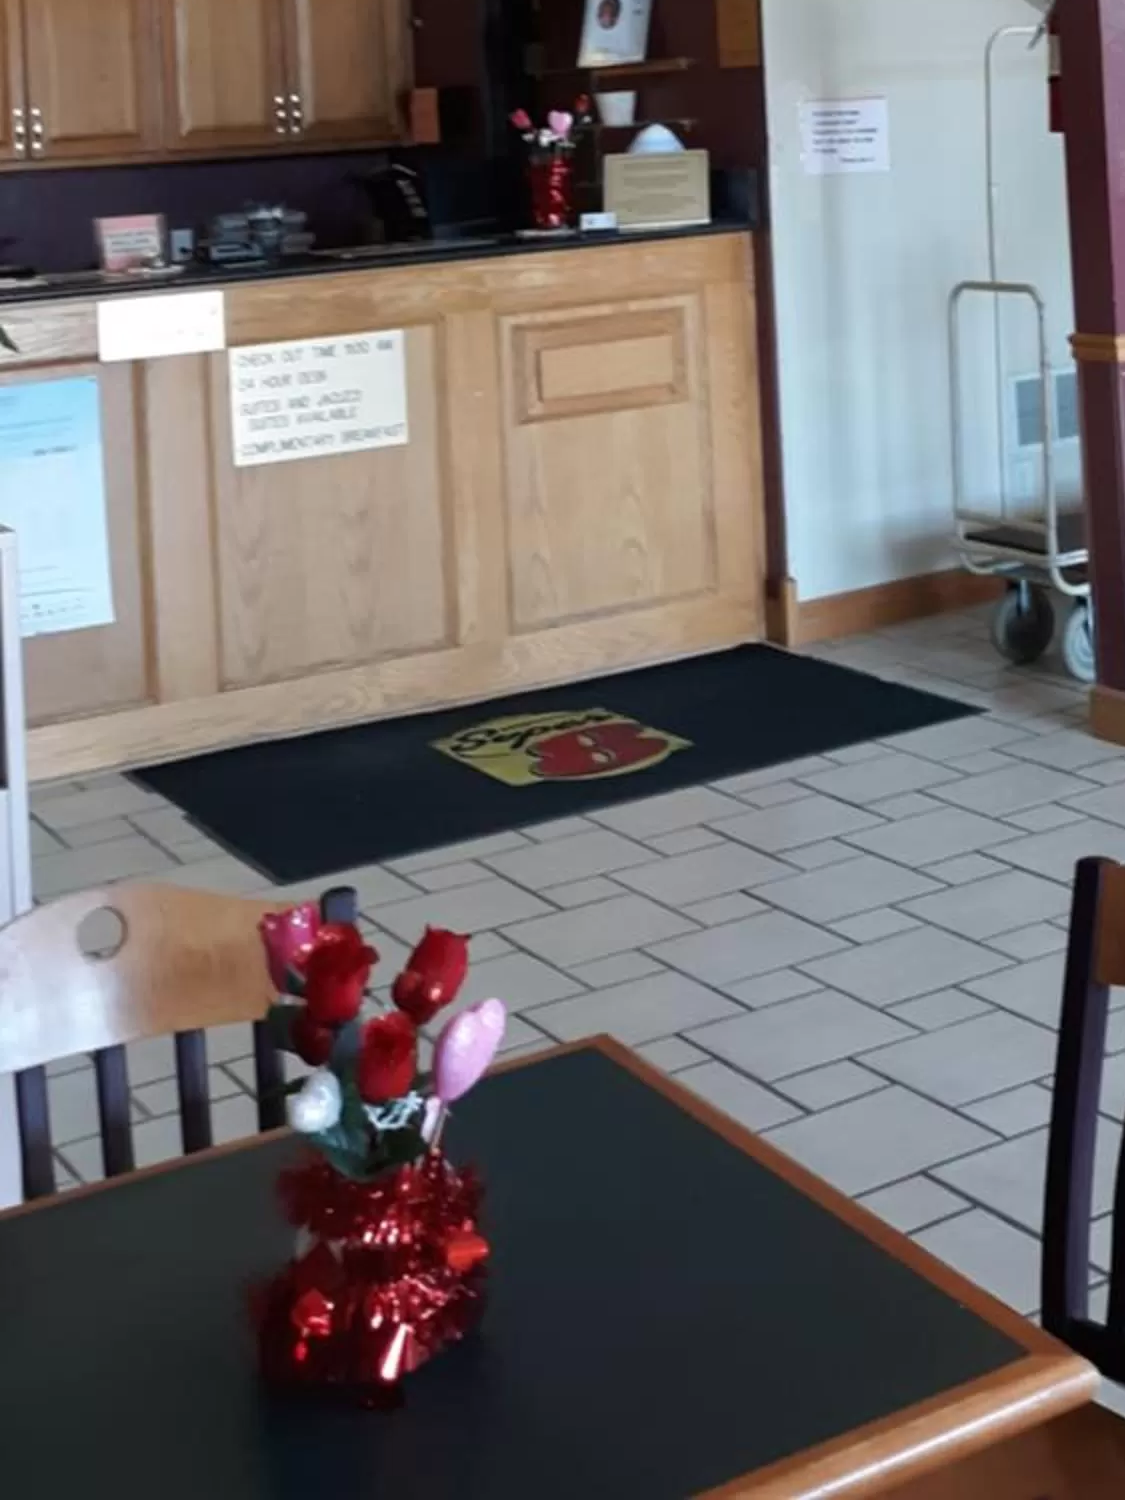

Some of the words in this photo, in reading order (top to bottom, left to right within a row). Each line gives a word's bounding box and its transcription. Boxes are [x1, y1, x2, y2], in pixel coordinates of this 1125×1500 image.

[238, 353, 274, 368] CHECK
[281, 348, 303, 362] OUT
[312, 344, 336, 357] TIME
[261, 374, 291, 387] HOUR
[288, 396, 310, 408] AND
[296, 406, 358, 424] AVAILABLE
[450, 712, 614, 752] Super
